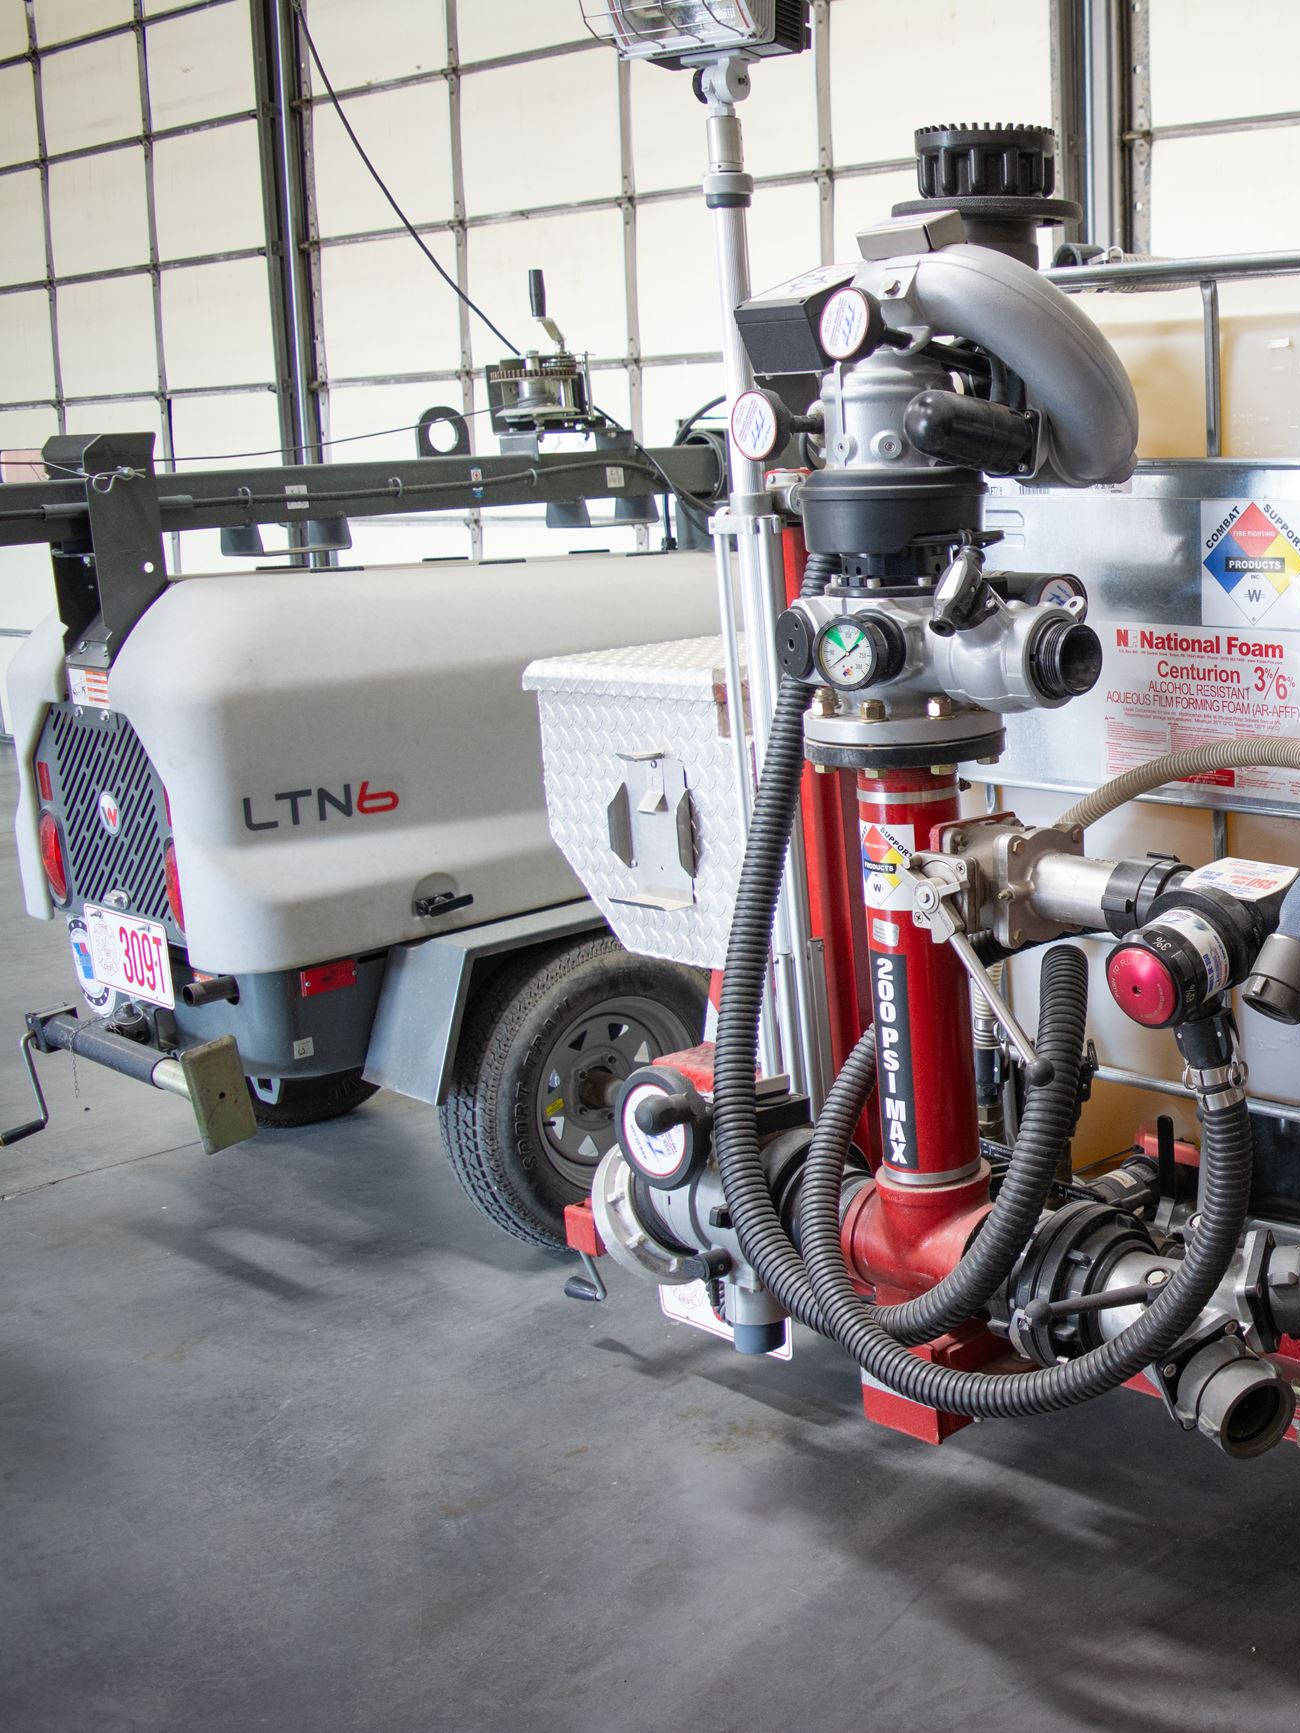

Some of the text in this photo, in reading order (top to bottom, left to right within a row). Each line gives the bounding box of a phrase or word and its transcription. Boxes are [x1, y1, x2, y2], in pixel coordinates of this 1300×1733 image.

[1206, 506, 1241, 549] COMBAT
[1229, 560, 1280, 570] PRODUCTS
[1140, 630, 1220, 654] National
[1226, 636, 1284, 658] Foam
[1157, 660, 1240, 684] Centurion
[1106, 690, 1300, 722] AQUEOUS FILM FORMING FOAM (AR-AFFF)
[1148, 680, 1251, 700] ALCOHOL RESISTANT
[243, 780, 399, 831] LTN6
[880, 827, 913, 858] SUPPORT
[864, 860, 894, 872] PRODUCTS
[1153, 936, 1172, 950] 3%
[876, 957, 897, 1022] 200
[524, 996, 570, 1066] TRAIL
[882, 1026, 900, 1094] PSI
[515, 1082, 538, 1170] SPORT
[885, 1096, 908, 1165] MAX
